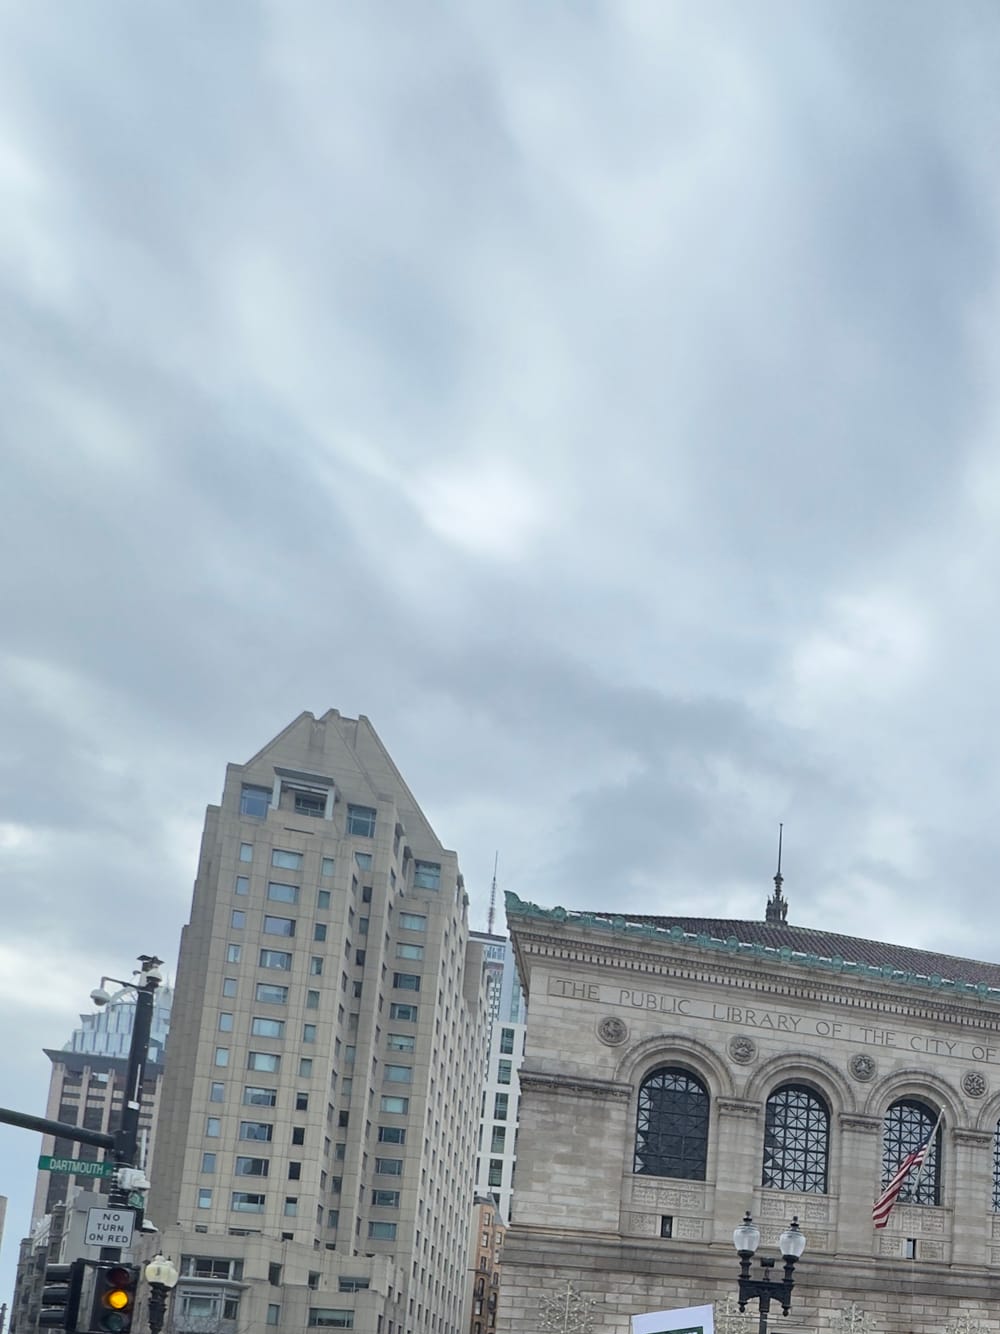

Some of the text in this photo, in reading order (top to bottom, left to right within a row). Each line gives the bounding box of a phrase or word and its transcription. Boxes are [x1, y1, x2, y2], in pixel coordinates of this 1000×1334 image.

[557, 980, 600, 1000] THE
[619, 990, 692, 1015] PUBLIC
[713, 1004, 802, 1032] LIBRARY
[815, 1021, 842, 1038] OF
[860, 1027, 896, 1047] THE
[910, 1036, 957, 1055] CITY
[971, 1046, 996, 1062] OF
[49, 1159, 104, 1174] DARTMOUTH
[103, 1213, 120, 1221] NO
[97, 1223, 124, 1232] TURN
[107, 1234, 128, 1242] RED
